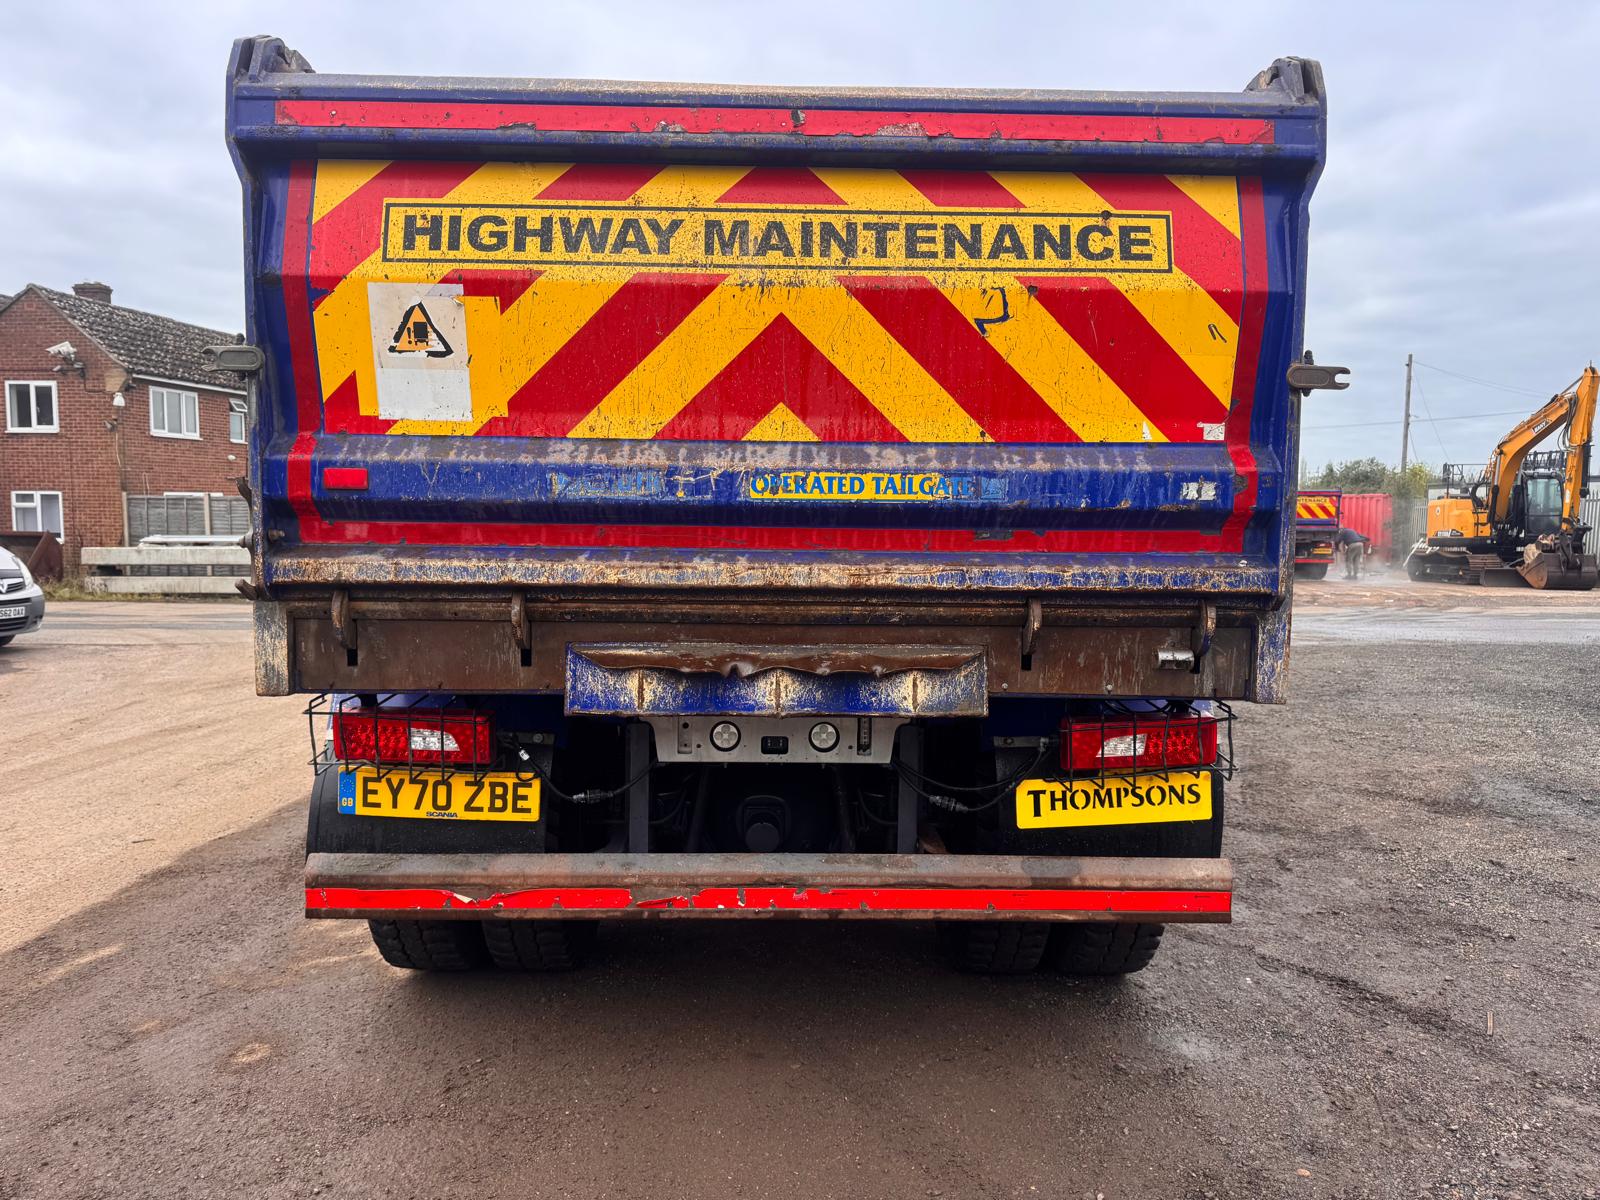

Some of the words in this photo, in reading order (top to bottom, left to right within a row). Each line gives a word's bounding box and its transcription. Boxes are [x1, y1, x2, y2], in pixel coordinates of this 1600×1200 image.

[402, 214, 684, 256] HIGHWAY
[702, 218, 1154, 262] MAINTENANCE
[750, 474, 865, 495] OPERATED
[871, 475, 975, 496] TAILGATE
[341, 797, 353, 807] GB
[361, 776, 452, 812] EY70
[463, 780, 533, 814] ZBE
[1027, 783, 1201, 817] THOMPSONS
